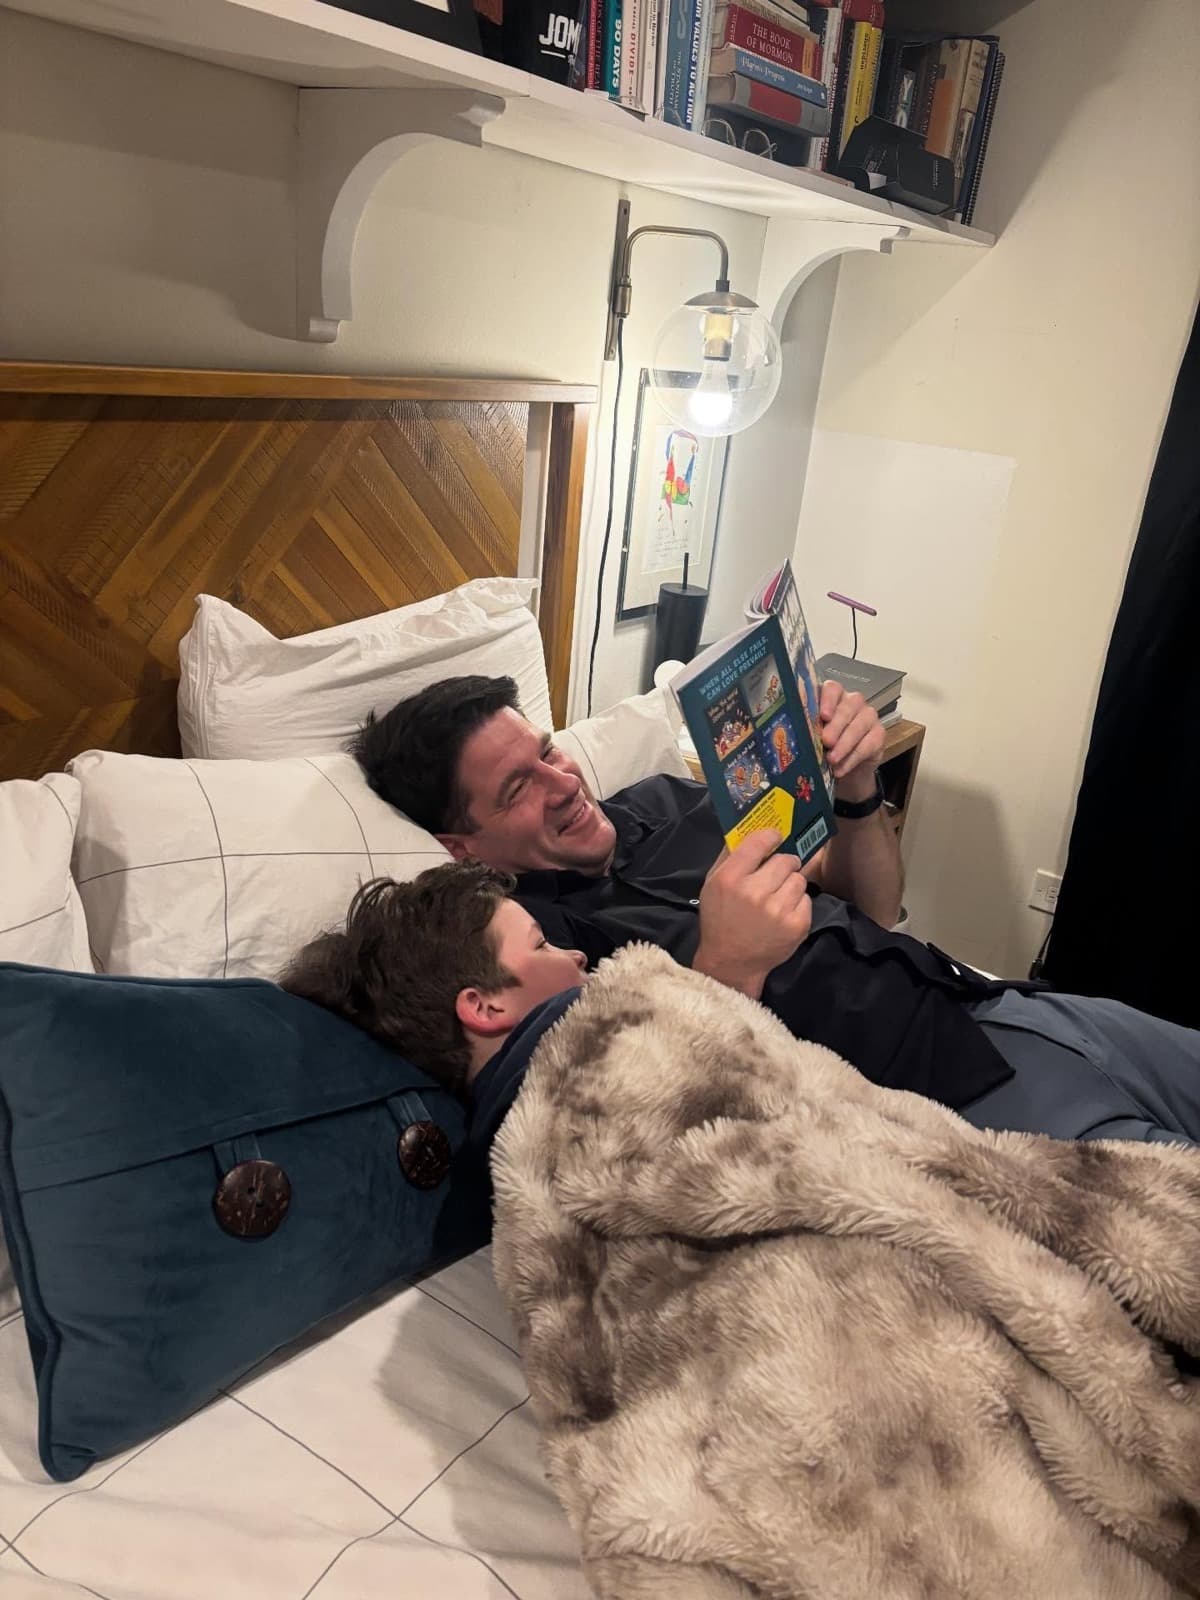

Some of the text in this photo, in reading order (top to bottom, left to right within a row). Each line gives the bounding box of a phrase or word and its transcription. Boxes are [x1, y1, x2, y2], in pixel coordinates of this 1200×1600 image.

[612, 19, 622, 89] 90 DAYS
[628, 33, 636, 74] DIVIDE
[691, 22, 701, 62] VALUES
[746, 35, 757, 49] OF
[759, 41, 793, 63] MORMON
[753, 23, 768, 37] THE
[770, 31, 792, 49] BOOK
[689, 63, 698, 80] TO
[686, 81, 696, 124] ACTION
[699, 675, 720, 695] WHEN
[721, 665, 733, 679] ALL
[732, 651, 749, 667] ELSE
[706, 686, 721, 700] CAN
[721, 670, 738, 688] LOVE
